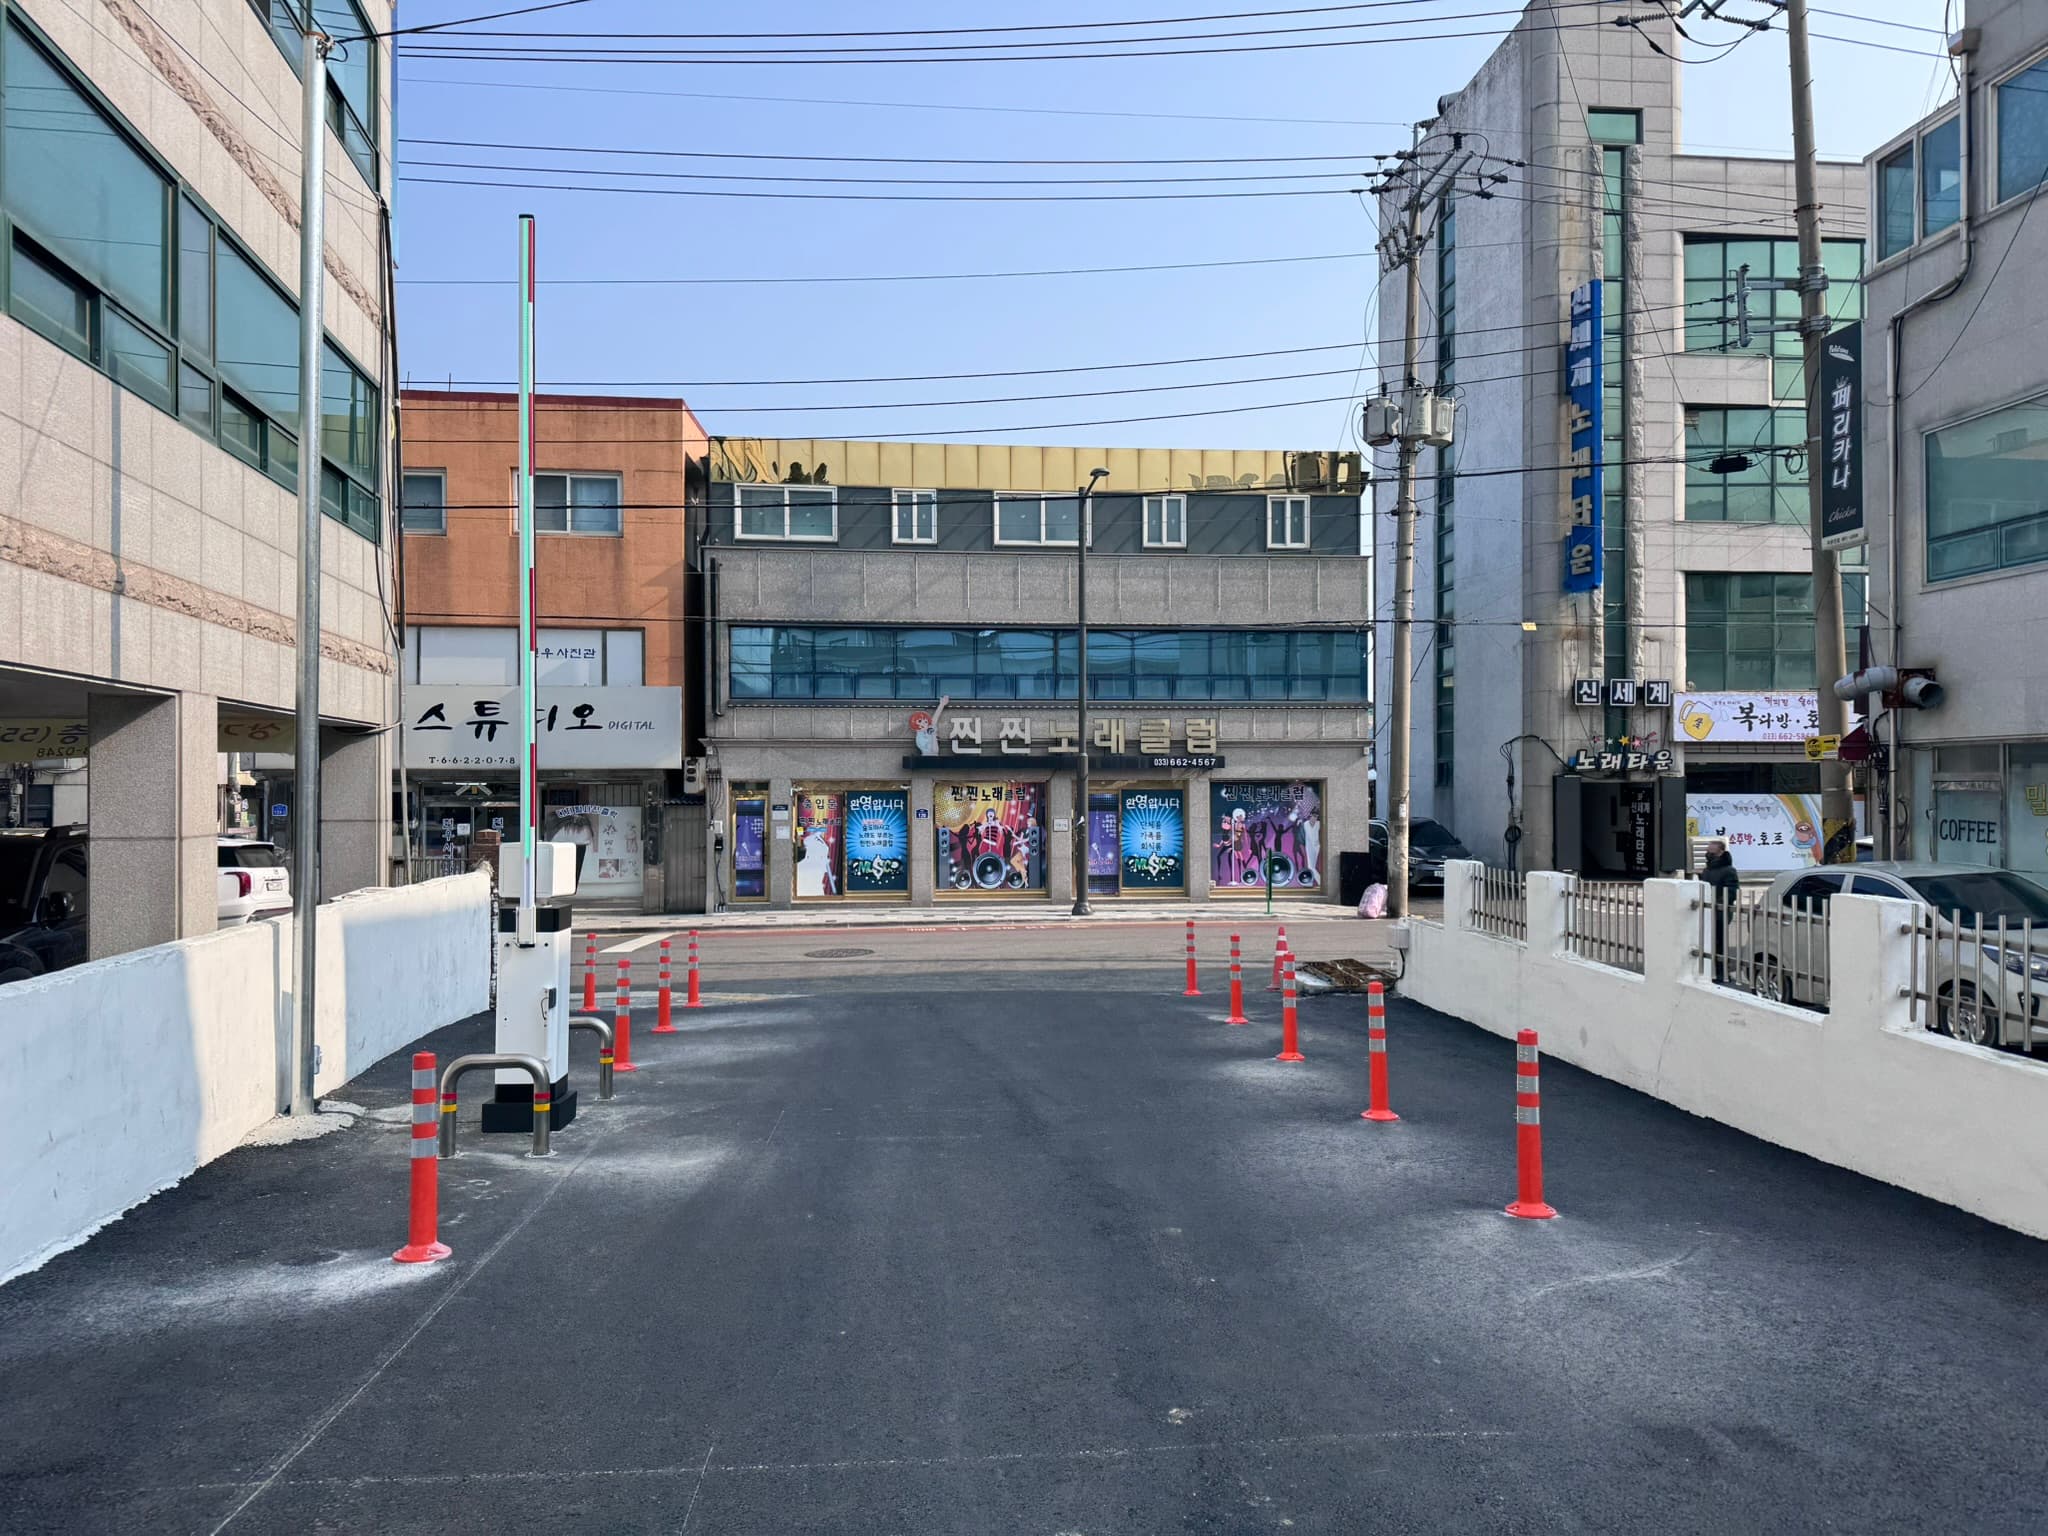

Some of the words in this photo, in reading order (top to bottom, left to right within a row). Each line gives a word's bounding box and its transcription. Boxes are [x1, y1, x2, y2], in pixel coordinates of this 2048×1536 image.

[1832, 384, 1852, 489] 페리카나
[535, 648, 597, 659] 우사진관
[1578, 681, 1669, 704] 신세계
[608, 720, 656, 731] DIGITAL
[1575, 749, 1674, 771] 노래타운
[1939, 819, 1998, 844] COFFEE
